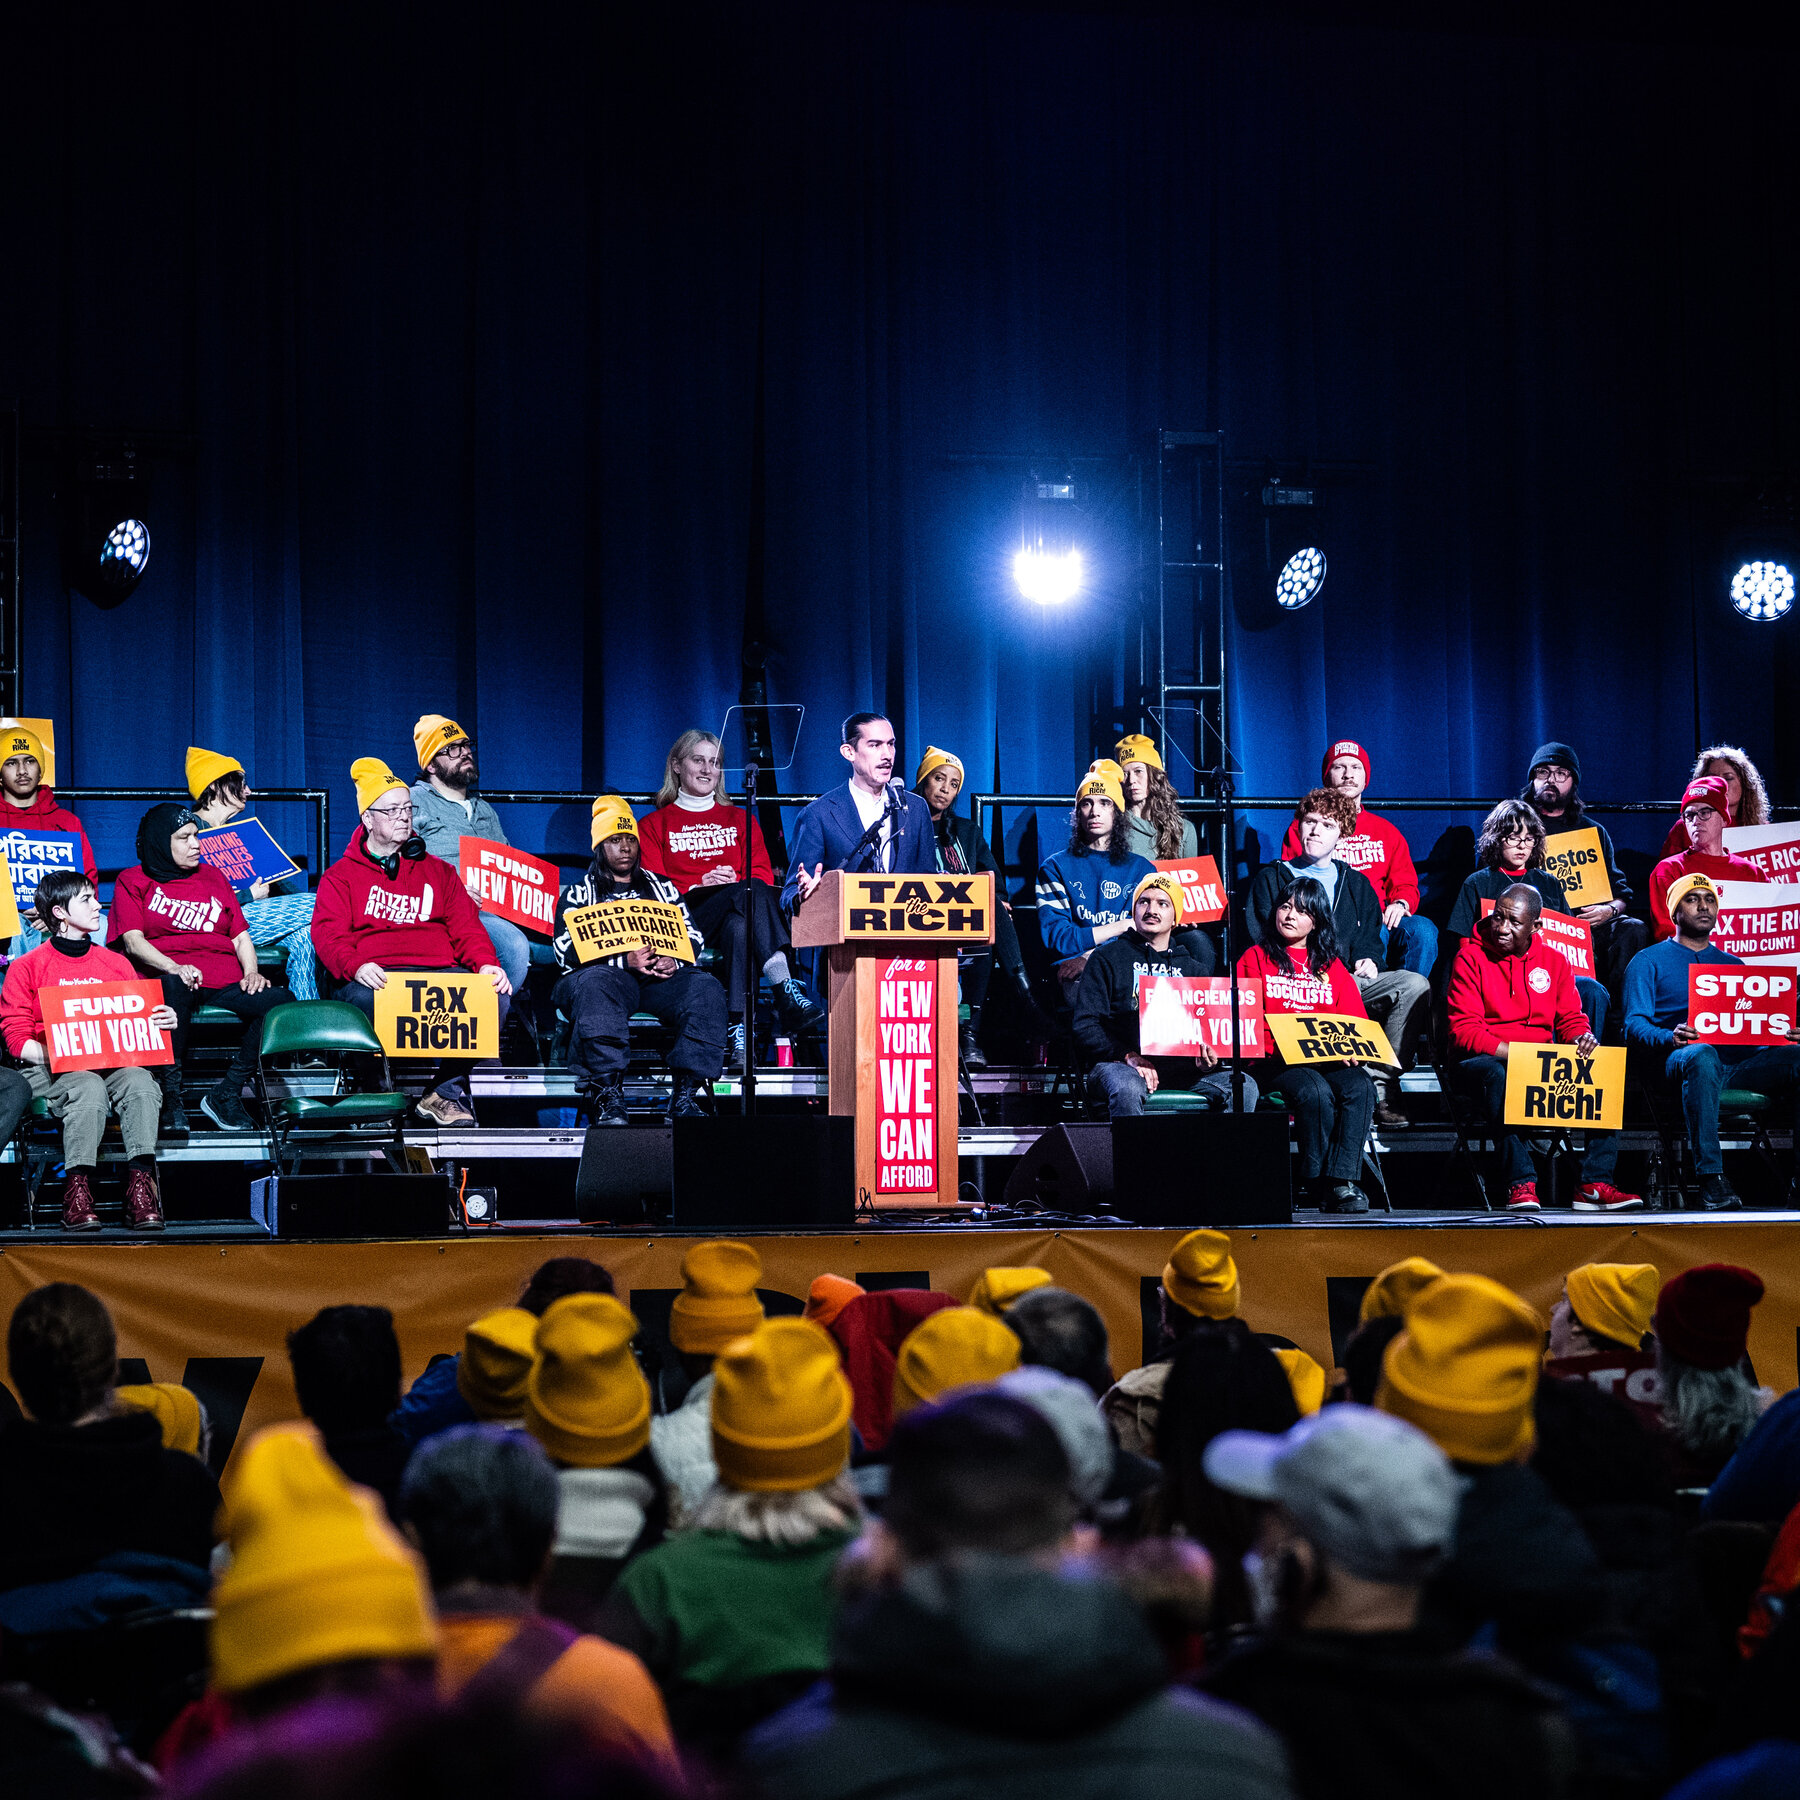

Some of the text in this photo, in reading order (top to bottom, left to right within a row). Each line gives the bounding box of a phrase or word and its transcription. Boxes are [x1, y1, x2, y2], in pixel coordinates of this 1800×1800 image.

[668, 826, 738, 840] DEMOCRATIC
[203, 846, 254, 869] FAMILIES
[480, 850, 544, 885] FUND
[1332, 848, 1385, 865] OCIALISTS
[220, 861, 257, 881] PARTY
[466, 866, 555, 924] NEW YORK
[858, 881, 975, 904] TAX
[573, 905, 677, 924] CHILD CARE!
[906, 897, 929, 916] the
[576, 914, 683, 942] HEALTHCARE!
[849, 908, 985, 931] RICH
[1739, 912, 1778, 935] THE
[594, 934, 677, 952] Tax the Rich!
[1724, 939, 1758, 953] FUND
[1760, 935, 1795, 952] CUNY!
[885, 955, 927, 980] for a
[405, 980, 468, 1014] Tax
[1266, 983, 1334, 1005] SOCIALISTS
[1694, 974, 1792, 998] STOP
[63, 995, 145, 1017] FUND
[880, 980, 933, 1018] NEW
[1735, 997, 1753, 1011] the
[428, 1008, 450, 1026] the
[1196, 1007, 1206, 1016] a
[396, 1016, 478, 1050] Rich!
[1296, 1016, 1361, 1037] Tax
[1694, 1011, 1791, 1036] CUTS
[51, 1016, 166, 1057] NEW YORK
[880, 1023, 932, 1054] YORK
[1326, 1032, 1349, 1043] the
[1297, 1037, 1380, 1060] Rich!
[1537, 1050, 1595, 1086] Tax
[880, 1059, 933, 1114] WE
[1554, 1080, 1577, 1097] the
[1525, 1085, 1604, 1121] Rich!
[880, 1118, 933, 1160] CAN
[881, 1165, 933, 1188] AFFORD
